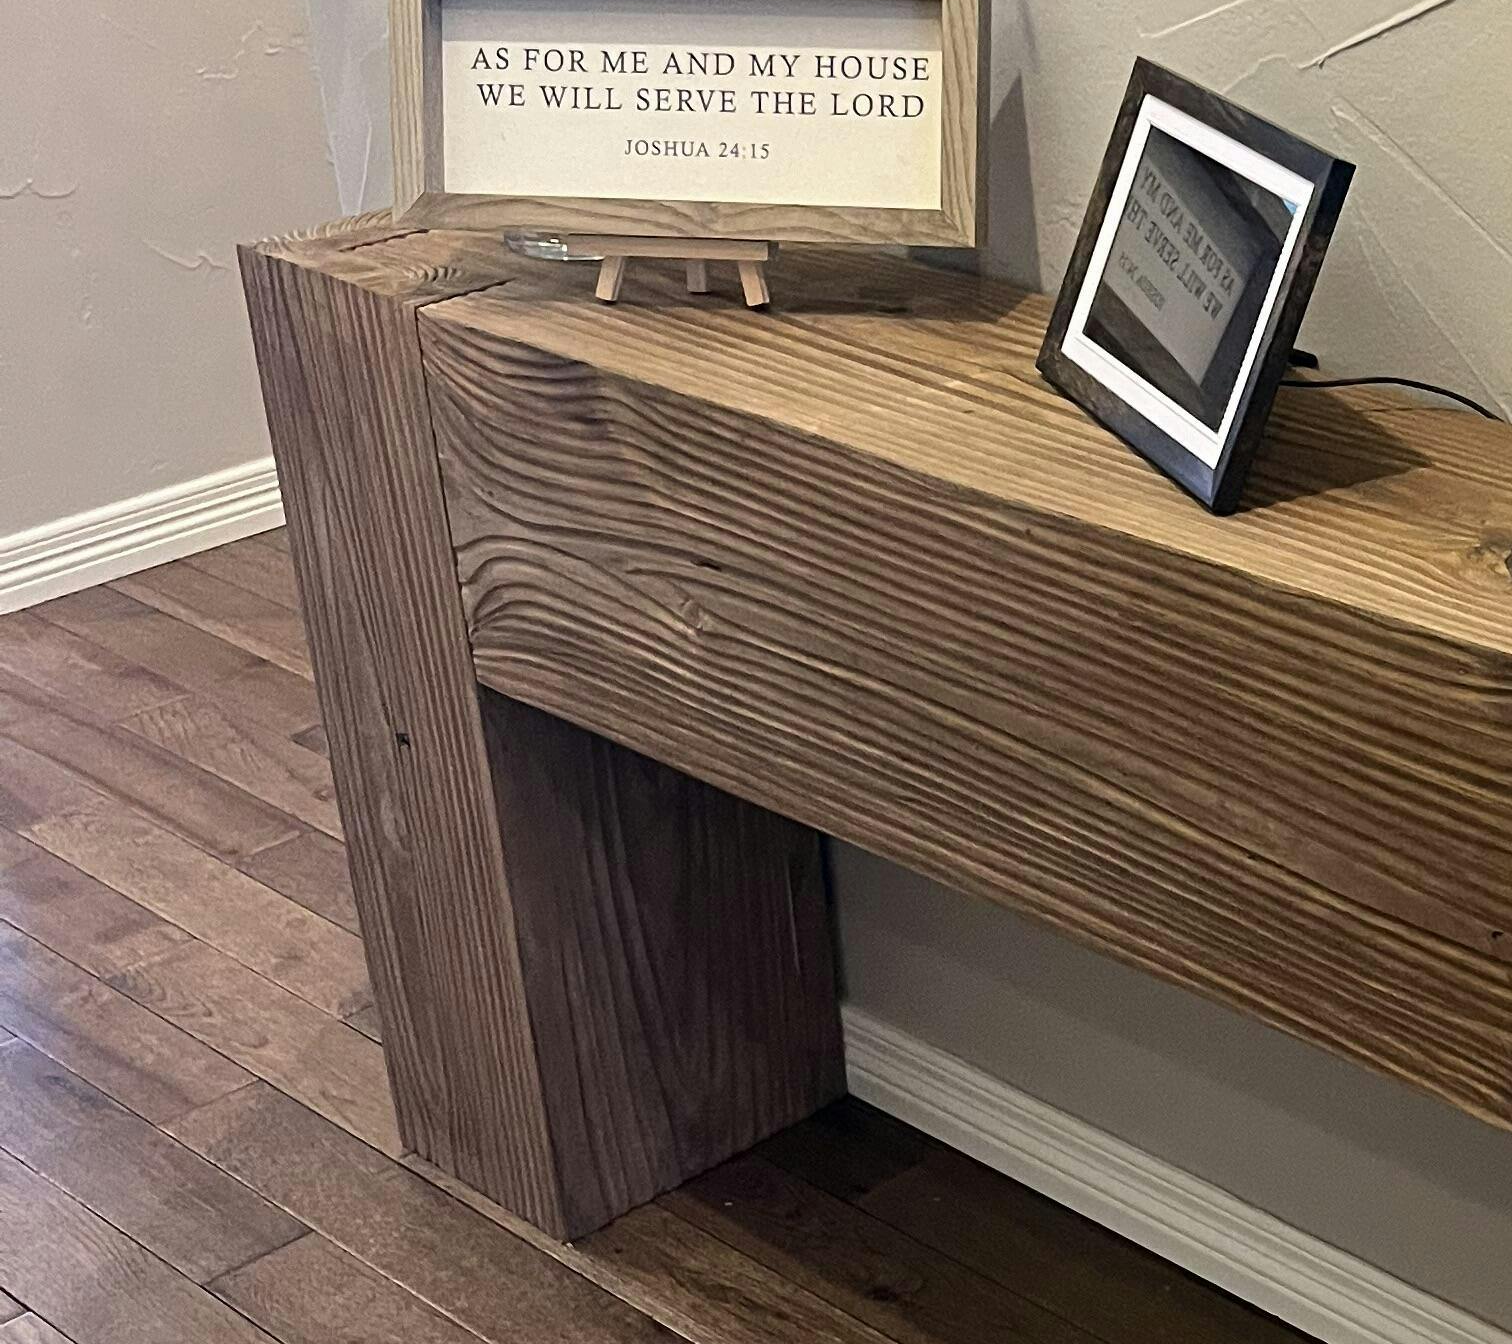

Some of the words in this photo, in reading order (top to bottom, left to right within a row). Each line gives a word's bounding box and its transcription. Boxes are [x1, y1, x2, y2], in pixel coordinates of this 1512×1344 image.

[470, 47, 510, 71] AS
[522, 48, 589, 73] FOR
[600, 49, 649, 74] ME
[661, 51, 735, 76] AND
[747, 53, 802, 78] MY
[813, 54, 930, 82] HOUSE
[475, 83, 526, 107] WE
[538, 84, 623, 110] WILL
[636, 87, 737, 114] SERVE
[750, 90, 817, 116] THE
[829, 92, 925, 119] LORD
[623, 139, 711, 158] JOSHUA
[718, 141, 770, 160] 24:15
